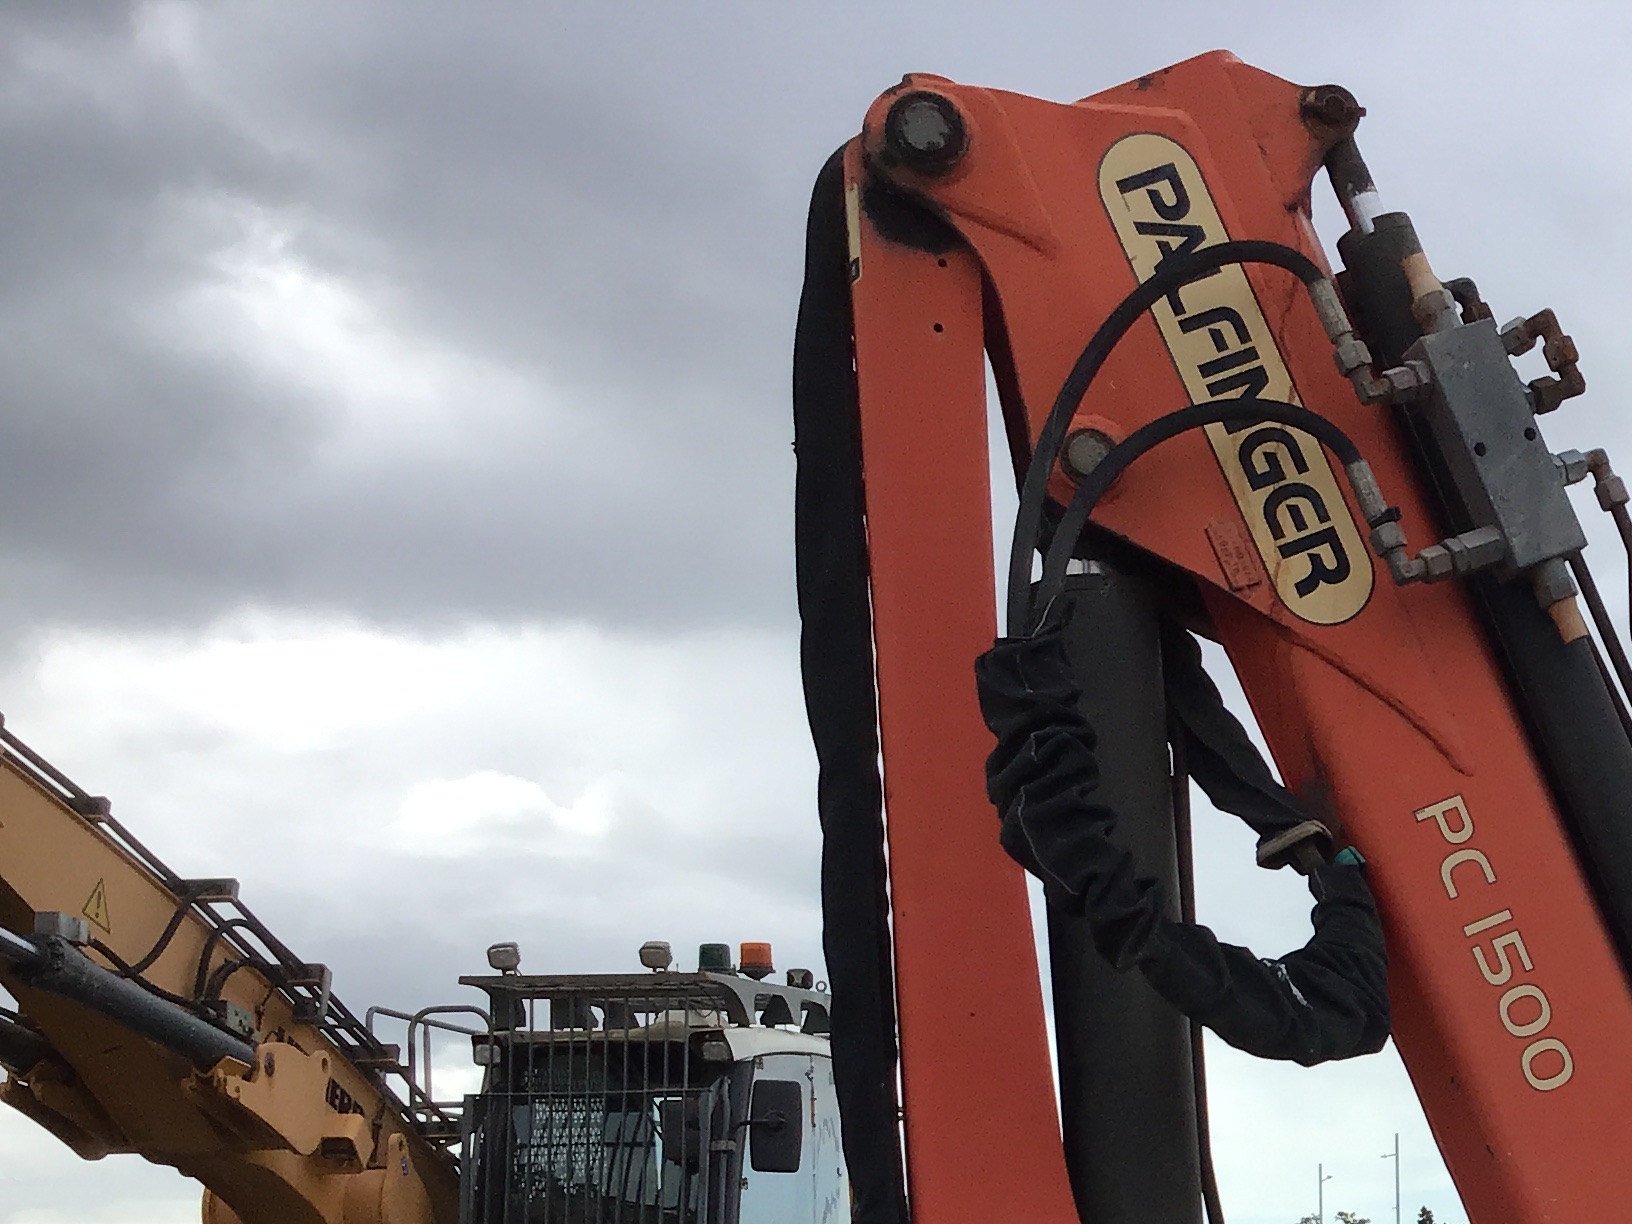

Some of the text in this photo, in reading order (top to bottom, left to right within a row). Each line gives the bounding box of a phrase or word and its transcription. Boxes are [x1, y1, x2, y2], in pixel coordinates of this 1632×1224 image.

[1116, 162, 1350, 598] PALFINGER
[1414, 794, 1574, 1091] PC 1500
